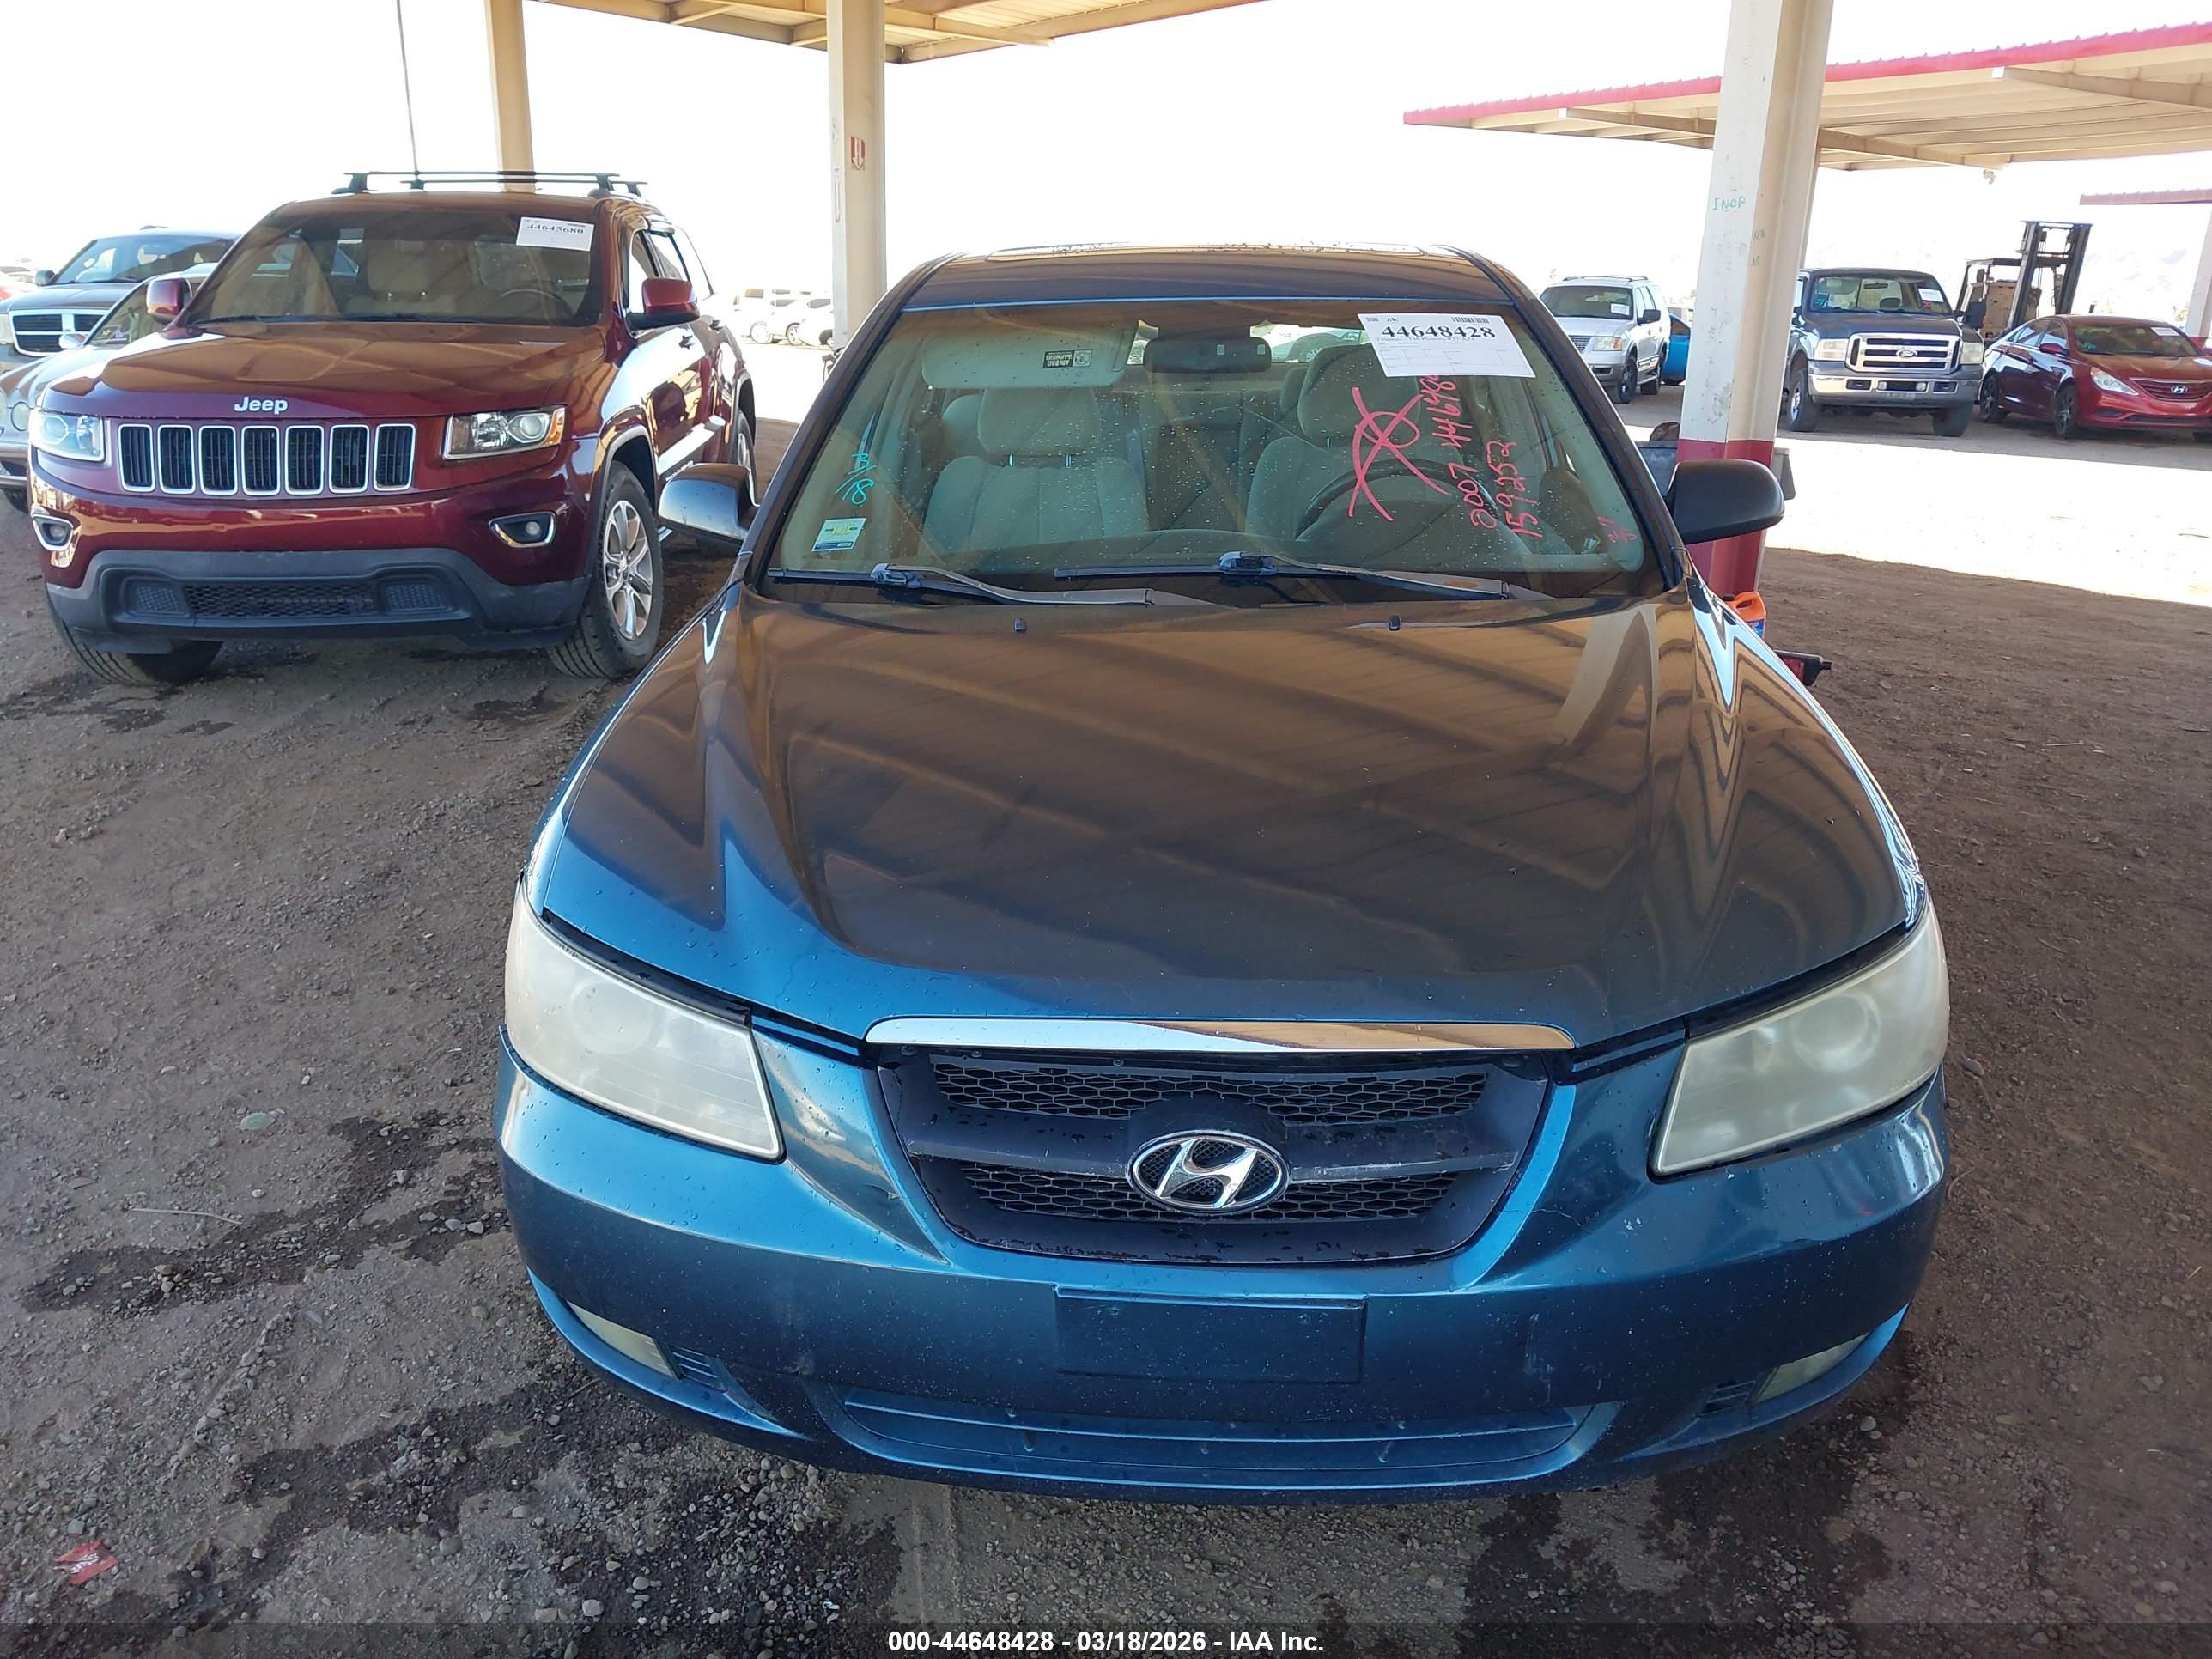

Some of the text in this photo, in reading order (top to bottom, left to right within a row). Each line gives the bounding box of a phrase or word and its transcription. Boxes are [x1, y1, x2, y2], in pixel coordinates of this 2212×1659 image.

[1712, 196, 1746, 210] INOP
[526, 223, 584, 234] 44645680
[1382, 325, 1496, 338] 44648428
[234, 396, 289, 415] Jeep
[1419, 375, 1473, 448] 44648
[1448, 462, 1498, 529] 2007
